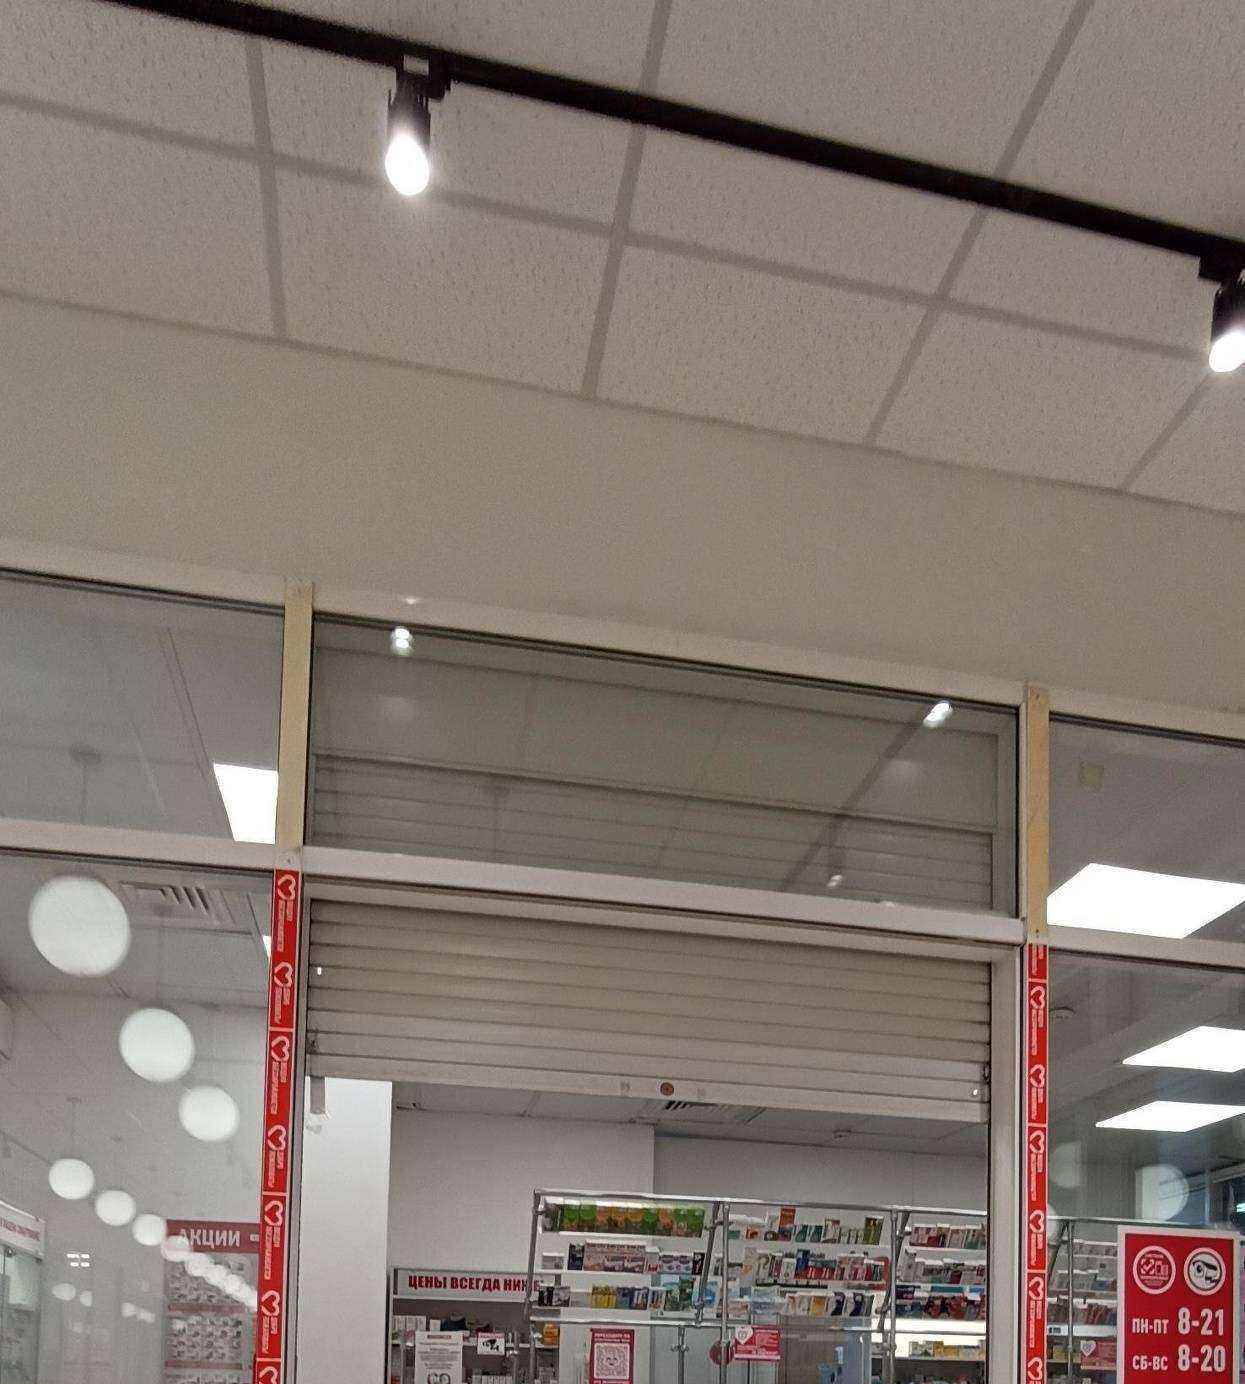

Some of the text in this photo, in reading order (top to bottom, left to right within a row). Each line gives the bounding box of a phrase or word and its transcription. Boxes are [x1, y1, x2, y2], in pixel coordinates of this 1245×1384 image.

[181, 1229, 240, 1248] АКЦИИ
[408, 1275, 447, 1290] ЦЕНЫ
[450, 1277, 500, 1292] ВСЕГДА
[1132, 1307, 1224, 1336] ПН-ПТ 8-21
[1132, 1344, 1226, 1372] СБ-ВС 8-20
